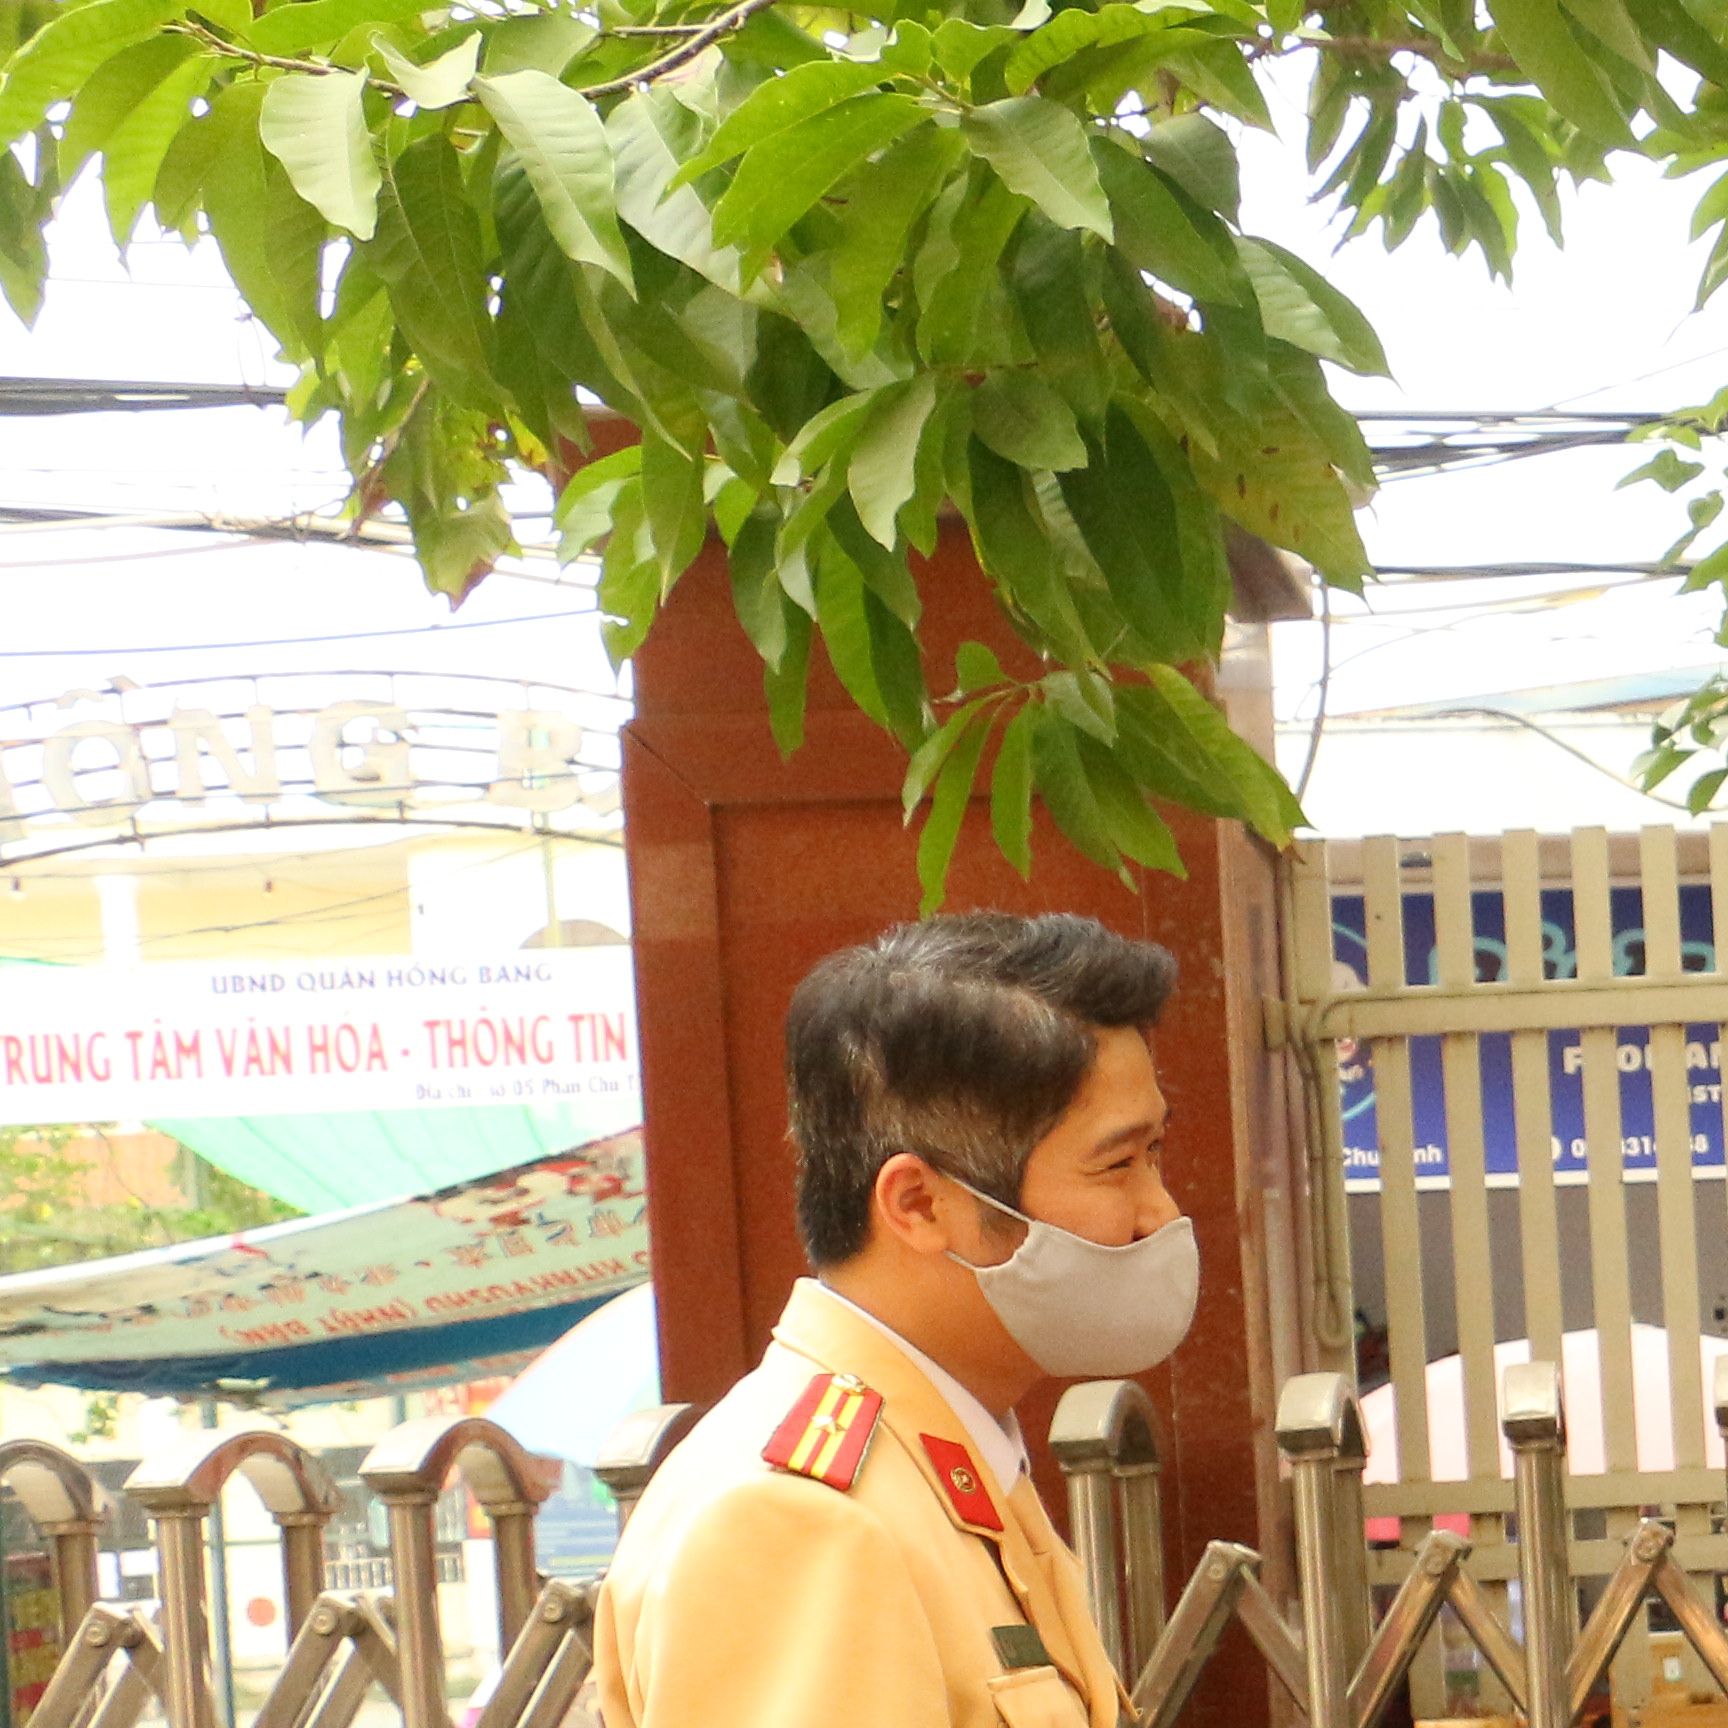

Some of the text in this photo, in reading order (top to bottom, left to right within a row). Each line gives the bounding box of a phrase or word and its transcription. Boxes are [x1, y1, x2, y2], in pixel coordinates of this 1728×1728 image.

[0, 675, 413, 841] ỒNG
[212, 975, 285, 995] UBND
[124, 1018, 204, 1081] TÂM
[423, 1006, 554, 1069] THÔNG
[567, 1012, 628, 1064] TIN
